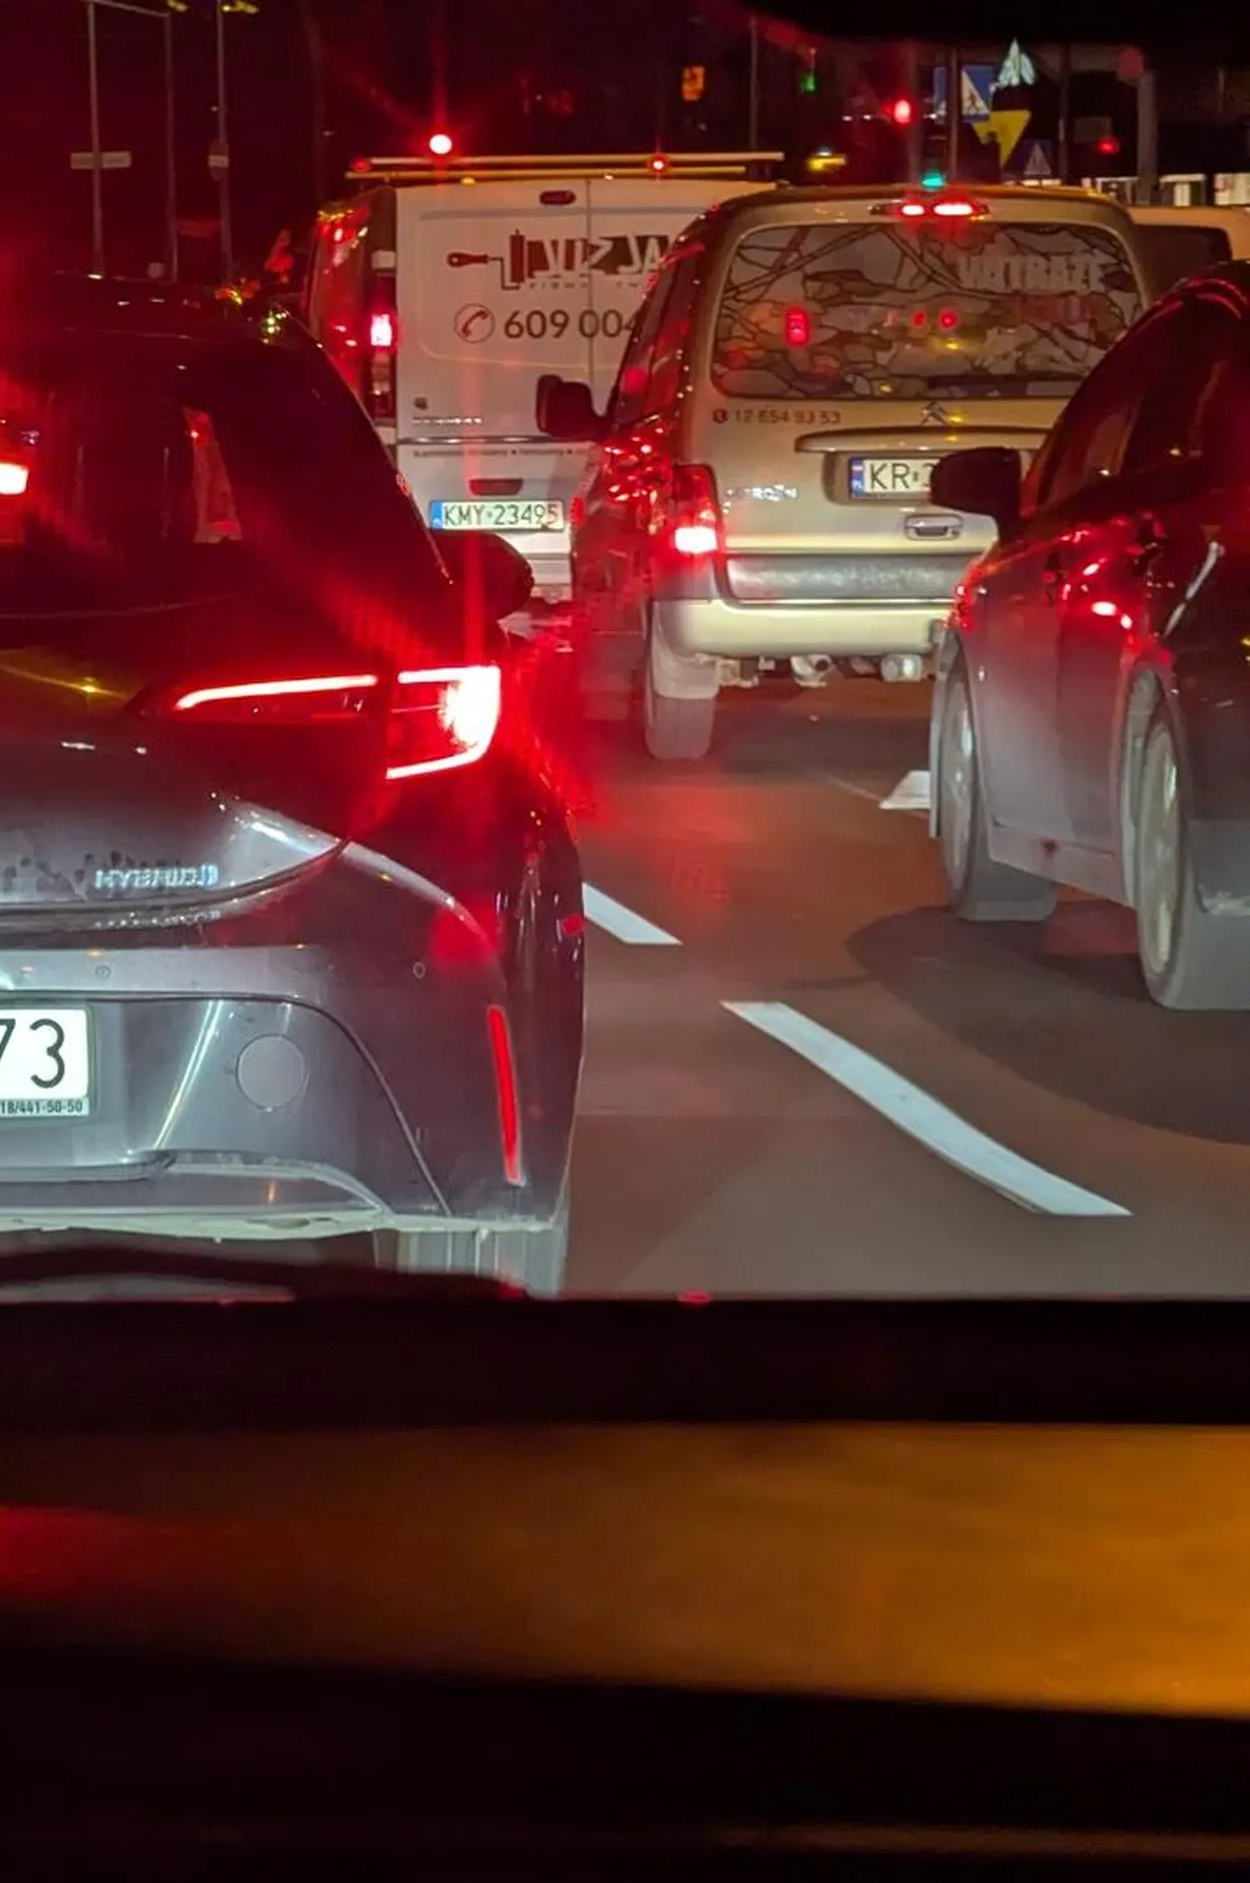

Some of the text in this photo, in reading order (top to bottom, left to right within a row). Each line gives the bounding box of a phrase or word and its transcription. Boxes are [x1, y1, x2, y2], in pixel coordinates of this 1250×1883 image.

[504, 309, 570, 339] 609
[869, 462, 910, 490] KR
[443, 503, 559, 526] KMY 23495
